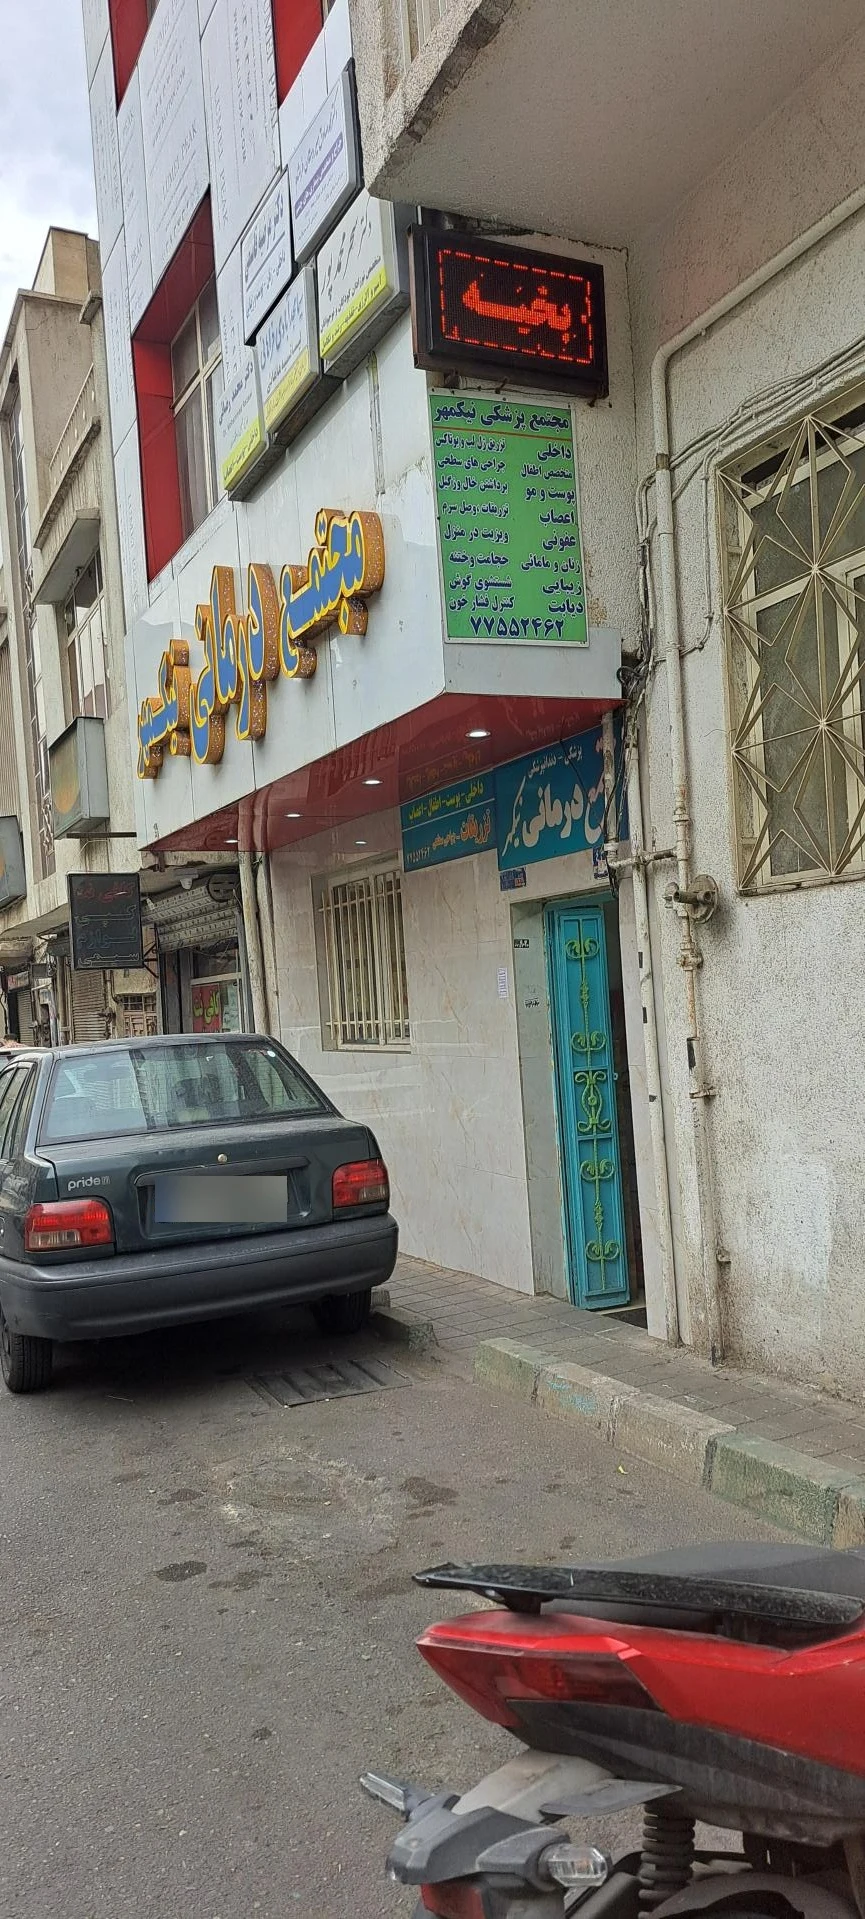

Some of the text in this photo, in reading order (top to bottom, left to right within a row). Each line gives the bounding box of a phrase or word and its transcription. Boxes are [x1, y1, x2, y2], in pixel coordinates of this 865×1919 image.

[433, 400, 570, 433] مجتمع پزشکی نیکمهر
[435, 432, 460, 449] بوتاکس
[466, 433, 475, 449] لب
[537, 442, 573, 462] داخلی
[437, 453, 507, 473] جراحی های سطحی
[521, 462, 574, 480] متخصص اطفال
[462, 475, 478, 491] خال
[480, 477, 508, 494] برداشتن
[525, 486, 576, 507] پوست و مو
[442, 501, 458, 516] سرم
[481, 500, 509, 518] تزریقات
[538, 507, 577, 529] اعصاب
[444, 522, 509, 544] ویزیت در منزل
[542, 530, 577, 552] عفونی
[476, 550, 509, 569] حجامت
[553, 560, 560, 574] و
[561, 557, 581, 575] زنان
[474, 574, 512, 591] شستشوی
[542, 577, 583, 596] زیبایی
[279, 508, 384, 679] مجتمع
[449, 593, 515, 613] کنترل فشار خون
[548, 598, 585, 619] دیابت
[470, 614, 564, 638] ۷۷۵۵۲۴۶۲
[189, 562, 279, 765] درمانی
[522, 783, 584, 848] درمانی
[67, 1176, 101, 1191] pride
